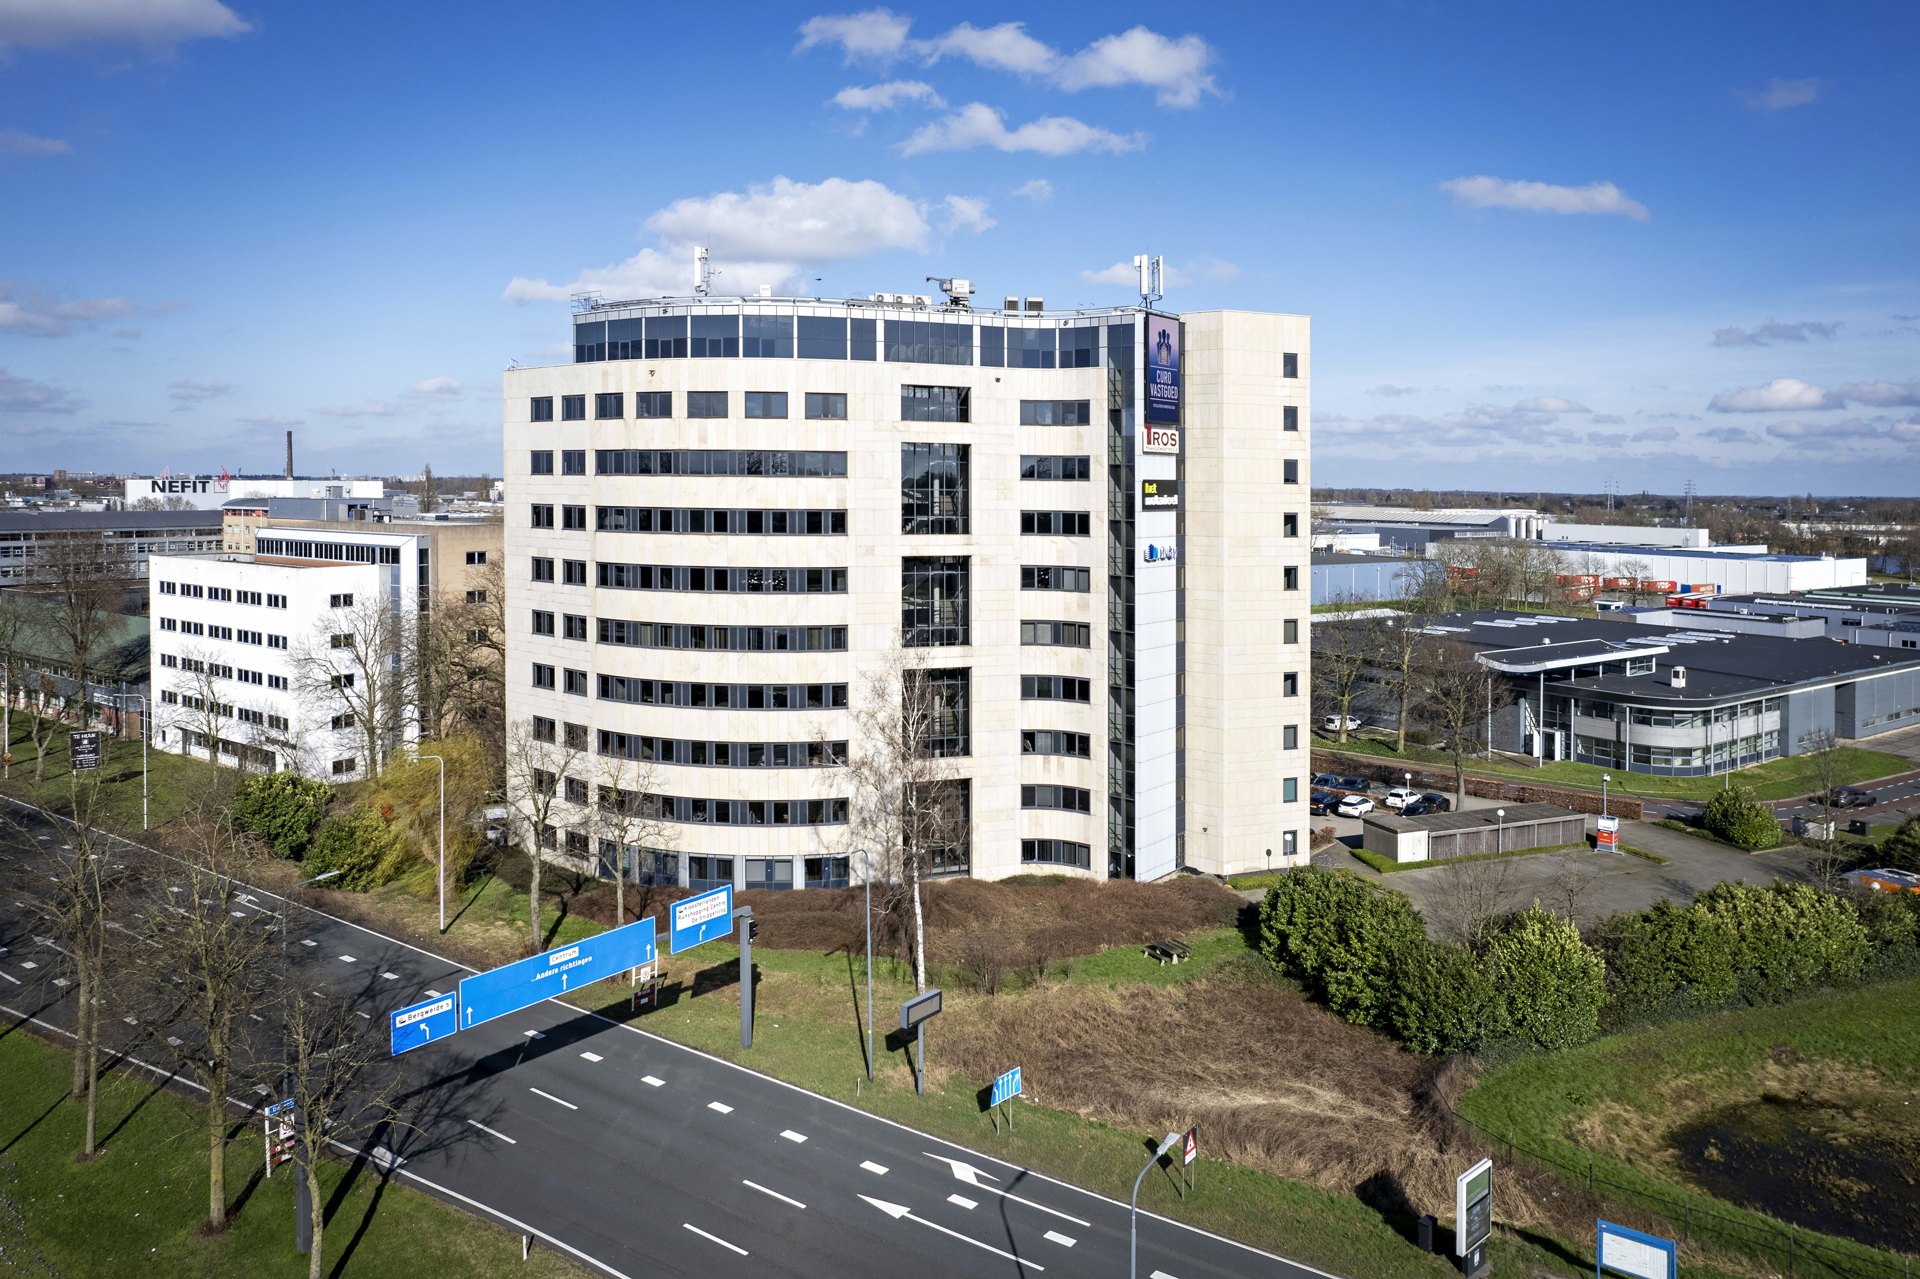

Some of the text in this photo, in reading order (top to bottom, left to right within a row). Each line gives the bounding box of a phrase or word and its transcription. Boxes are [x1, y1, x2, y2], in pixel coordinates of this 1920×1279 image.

[1156, 370, 1172, 384] CURO
[1150, 384, 1178, 398] VASTGOED
[152, 480, 210, 493] NEFIT
[1144, 482, 1158, 494] het
[678, 900, 726, 920] Runshopping Centre
[552, 949, 578, 962] Centrum
[536, 956, 592, 980] Andere richtingen
[408, 1004, 444, 1021] Bergweide
